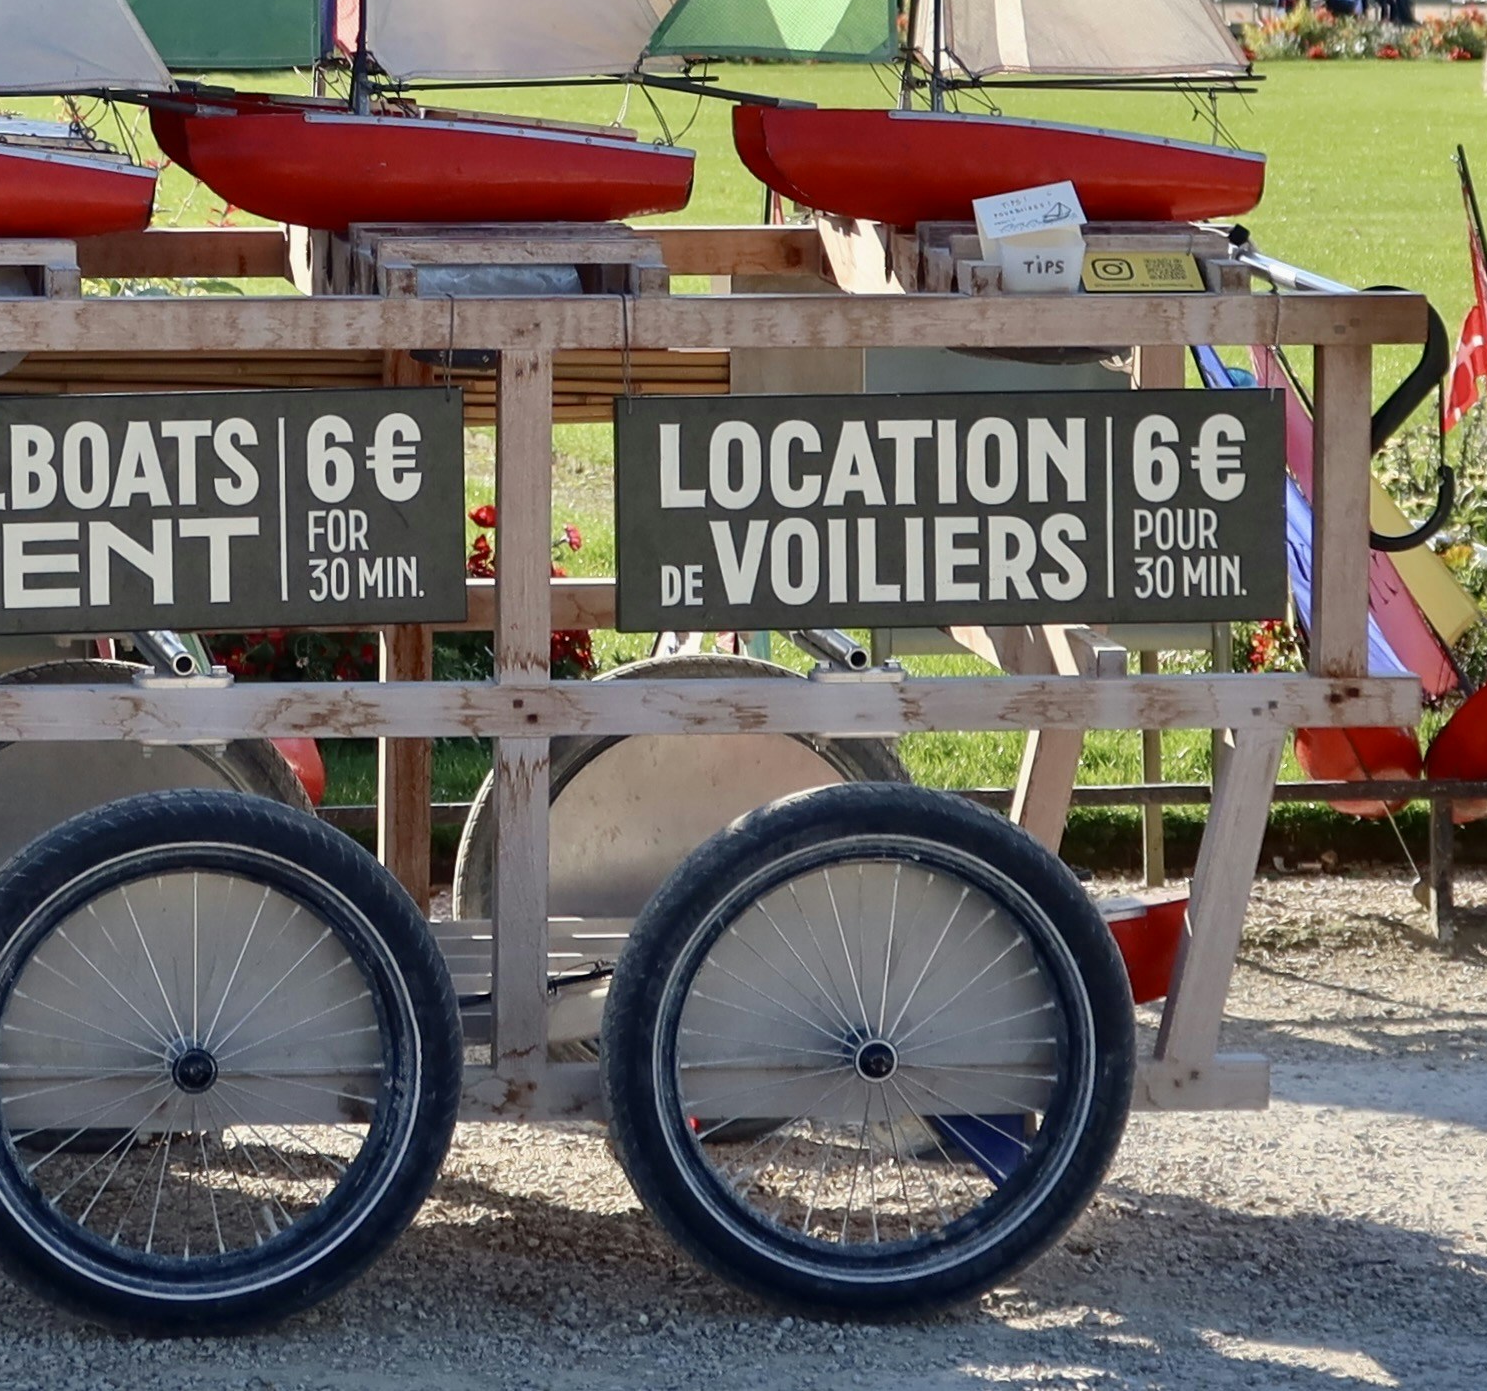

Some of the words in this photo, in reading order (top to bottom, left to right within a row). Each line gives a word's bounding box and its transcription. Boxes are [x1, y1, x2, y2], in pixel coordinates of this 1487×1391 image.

[659, 416, 1087, 510] LOCATION
[308, 509, 370, 552] FOR
[1133, 507, 1218, 551] POUR
[308, 557, 350, 602] 30
[358, 555, 425, 600] MIN.
[661, 564, 704, 607] DE
[708, 512, 1087, 606] VOILIERS
[1134, 555, 1175, 599] 30
[1182, 554, 1248, 598] MIN.
